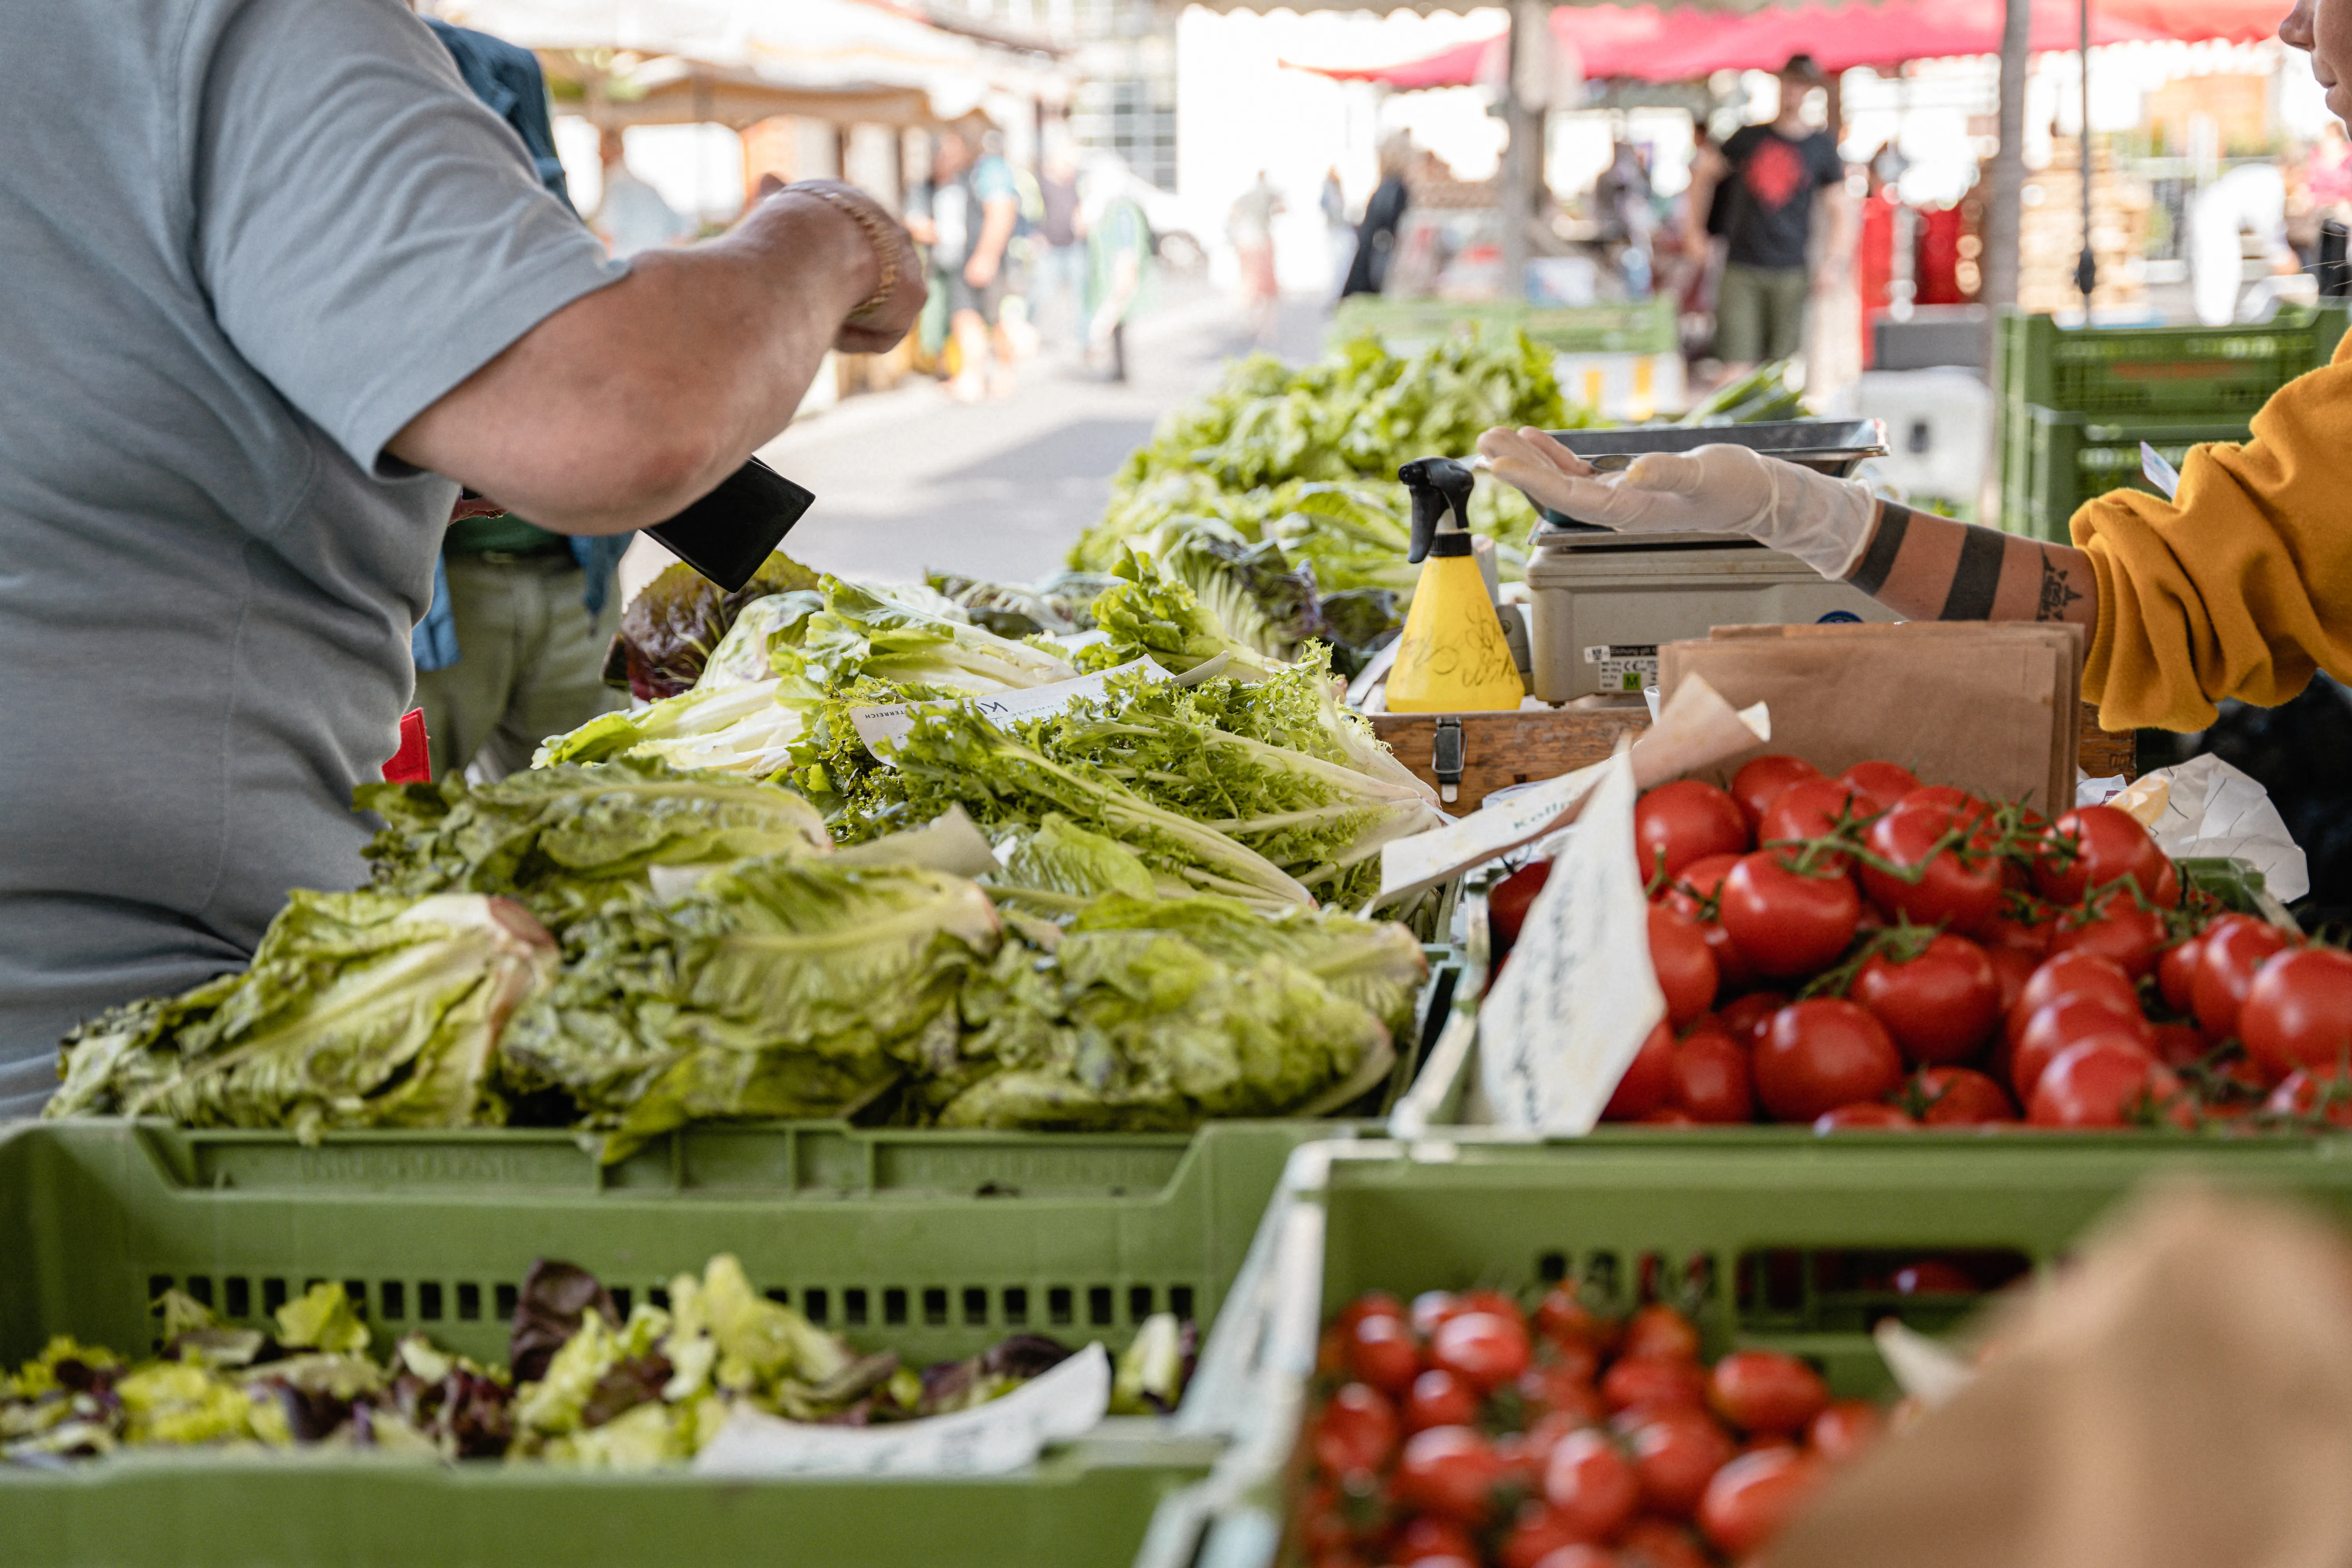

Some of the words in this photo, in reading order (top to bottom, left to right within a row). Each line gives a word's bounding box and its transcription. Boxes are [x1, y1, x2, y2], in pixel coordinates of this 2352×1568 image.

[1627, 676, 1638, 686] M
[865, 710, 906, 719] TERREICH
[1010, 705, 1053, 717] unsere
